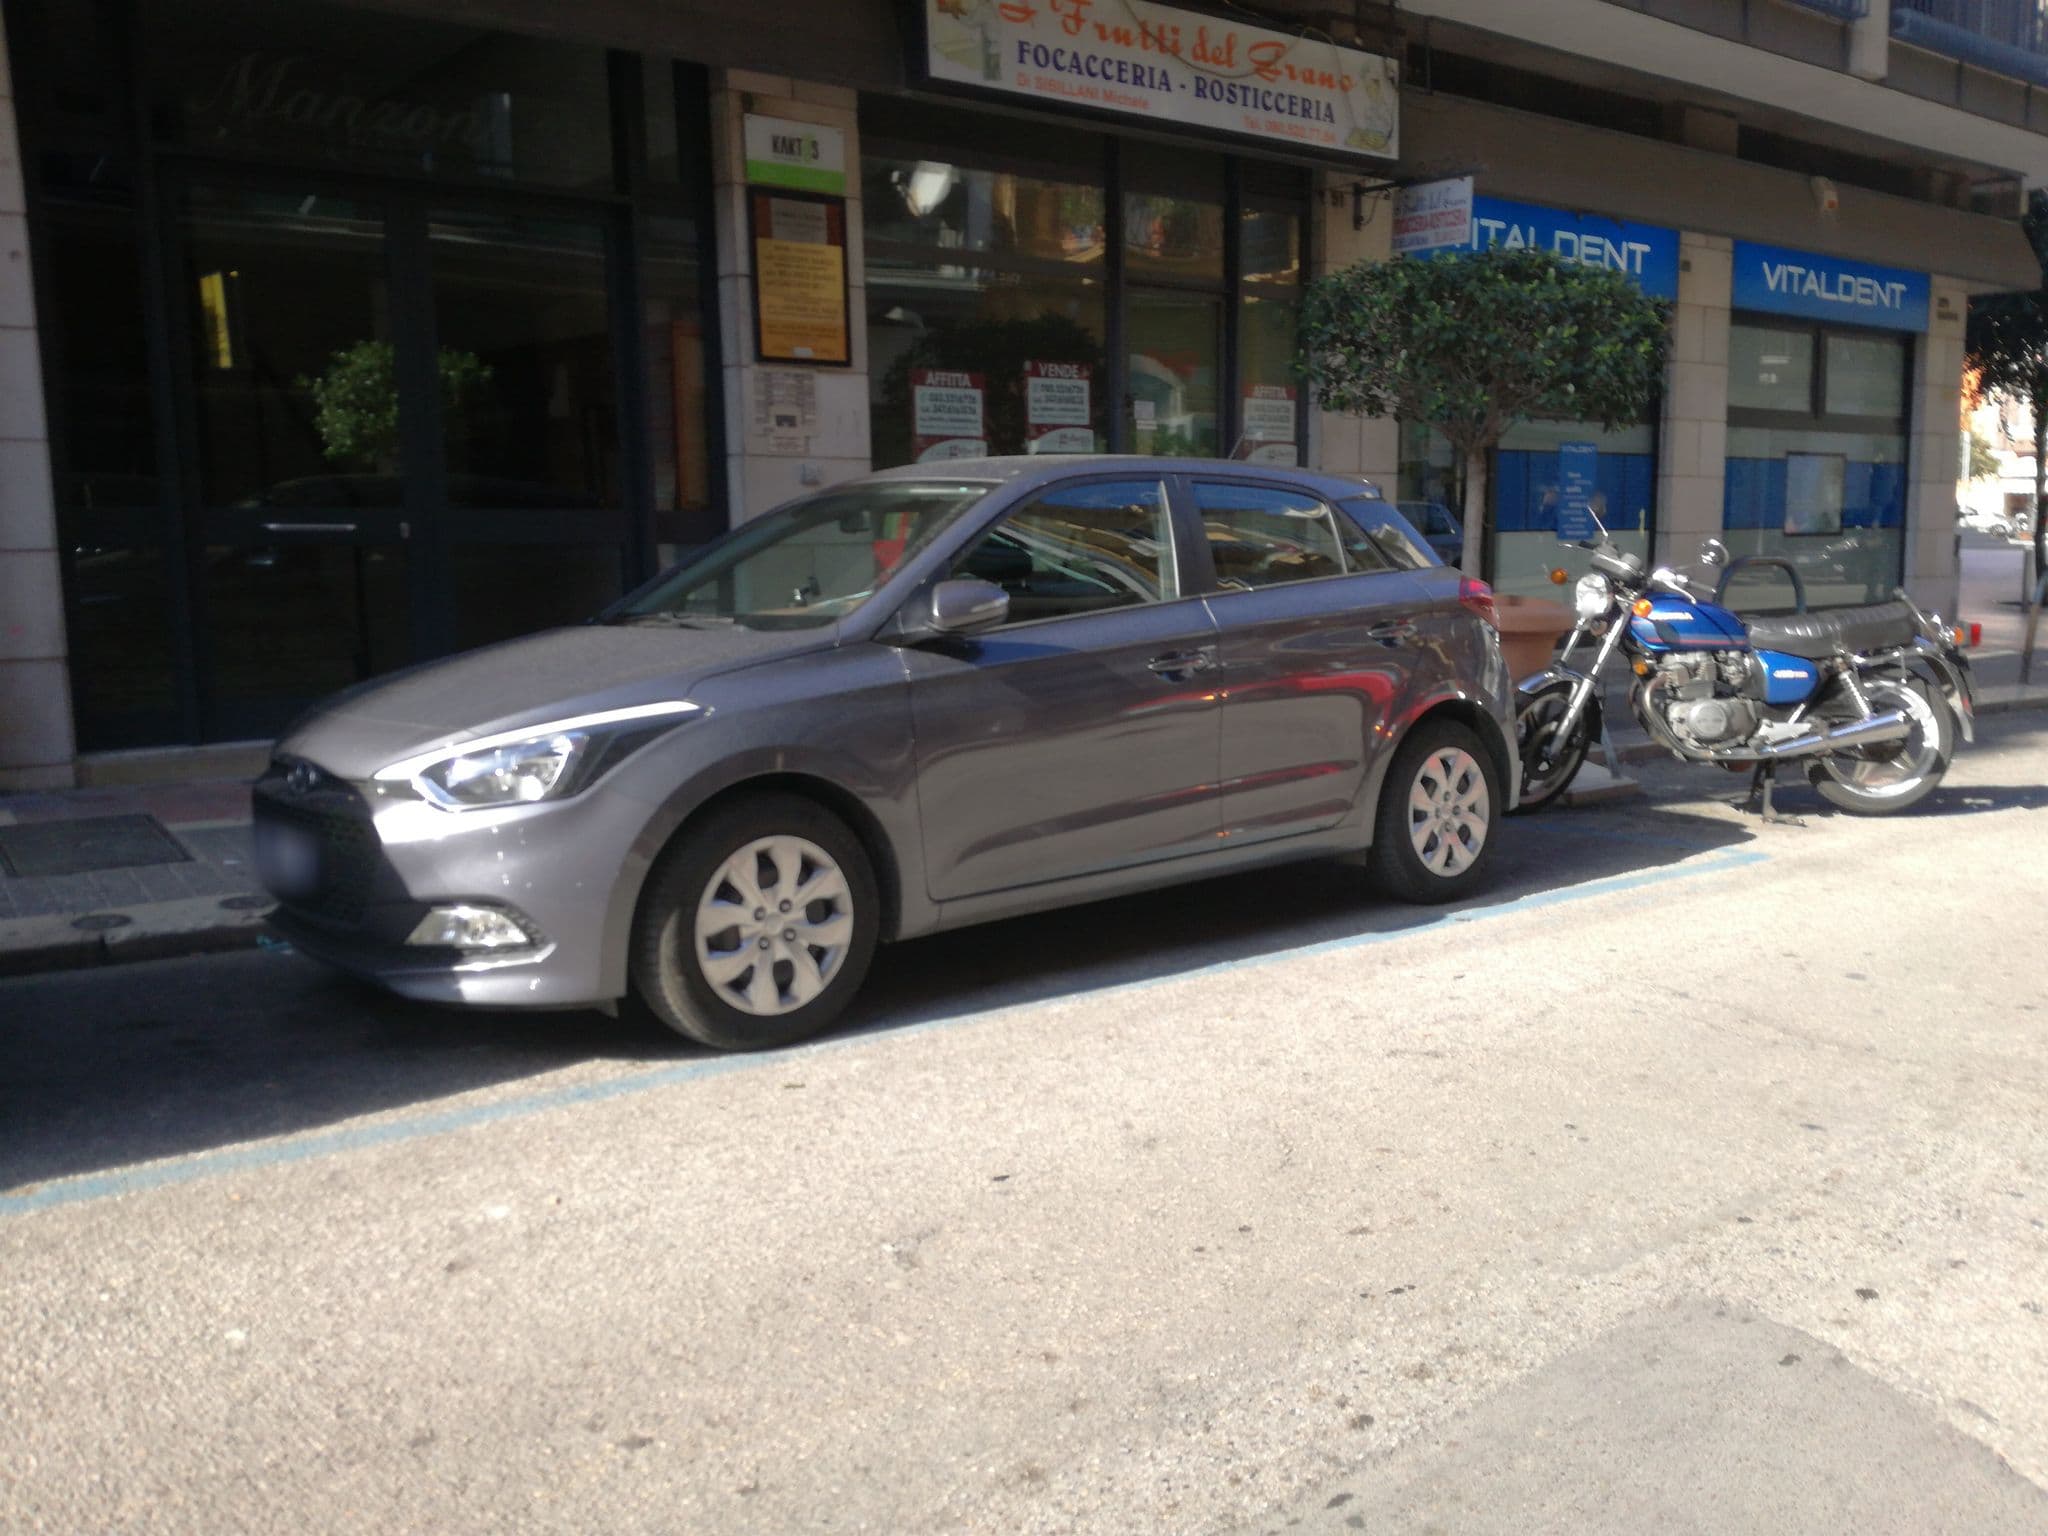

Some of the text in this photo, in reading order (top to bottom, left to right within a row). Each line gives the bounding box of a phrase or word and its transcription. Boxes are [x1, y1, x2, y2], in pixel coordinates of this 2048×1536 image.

[1049, 0, 1182, 55] Frutti
[1192, 26, 1237, 68] del
[1247, 42, 1356, 93] Grano
[1017, 40, 1172, 92] FOCACCERIA
[1194, 75, 1336, 124] ROSTICCERIA
[1454, 216, 1651, 277] ITALDENT
[1762, 261, 1907, 310] VITALDENT
[1039, 361, 1080, 378] VENDE
